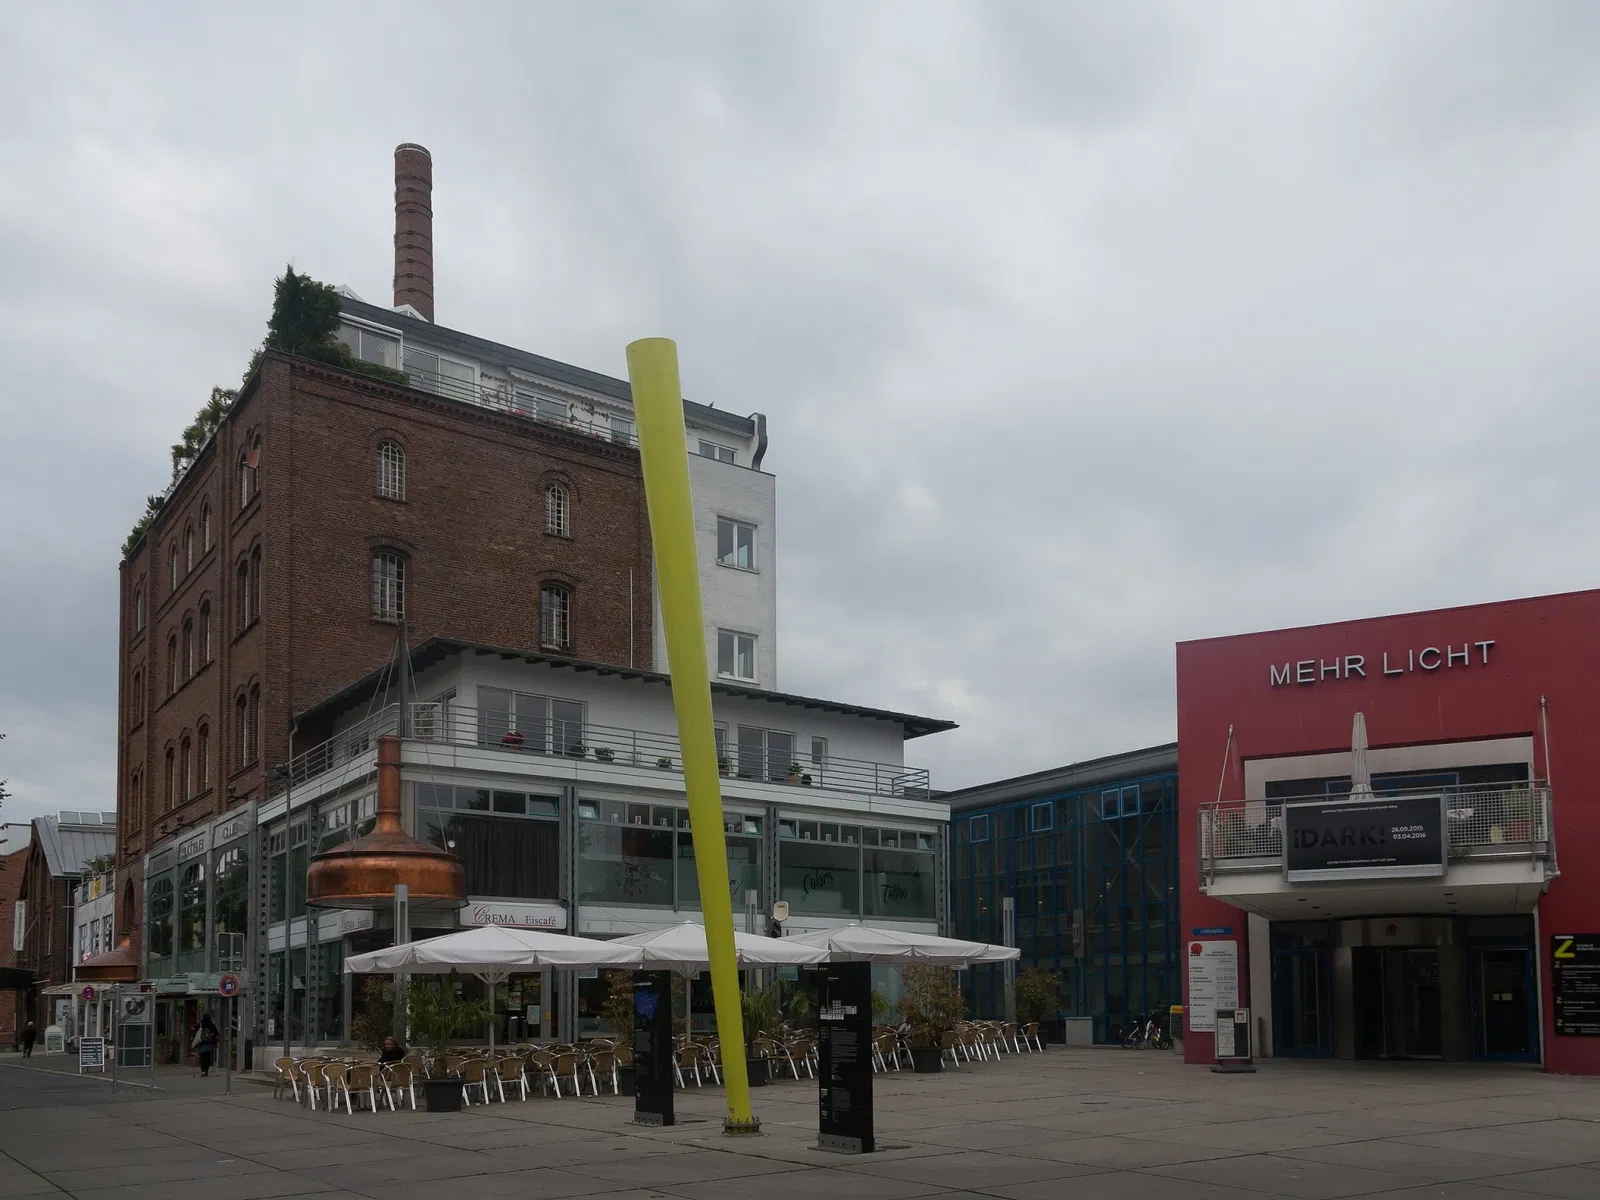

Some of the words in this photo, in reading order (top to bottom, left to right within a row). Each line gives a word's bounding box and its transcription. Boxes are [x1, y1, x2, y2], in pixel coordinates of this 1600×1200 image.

[1269, 653, 1366, 686] MEHR
[1383, 639, 1496, 675] LICHT
[1391, 825, 1424, 834] 26.09.2015
[1392, 832, 1427, 841] 03.04.2016
[472, 904, 516, 925] CREMA
[525, 915, 557, 926] Eiscafé
